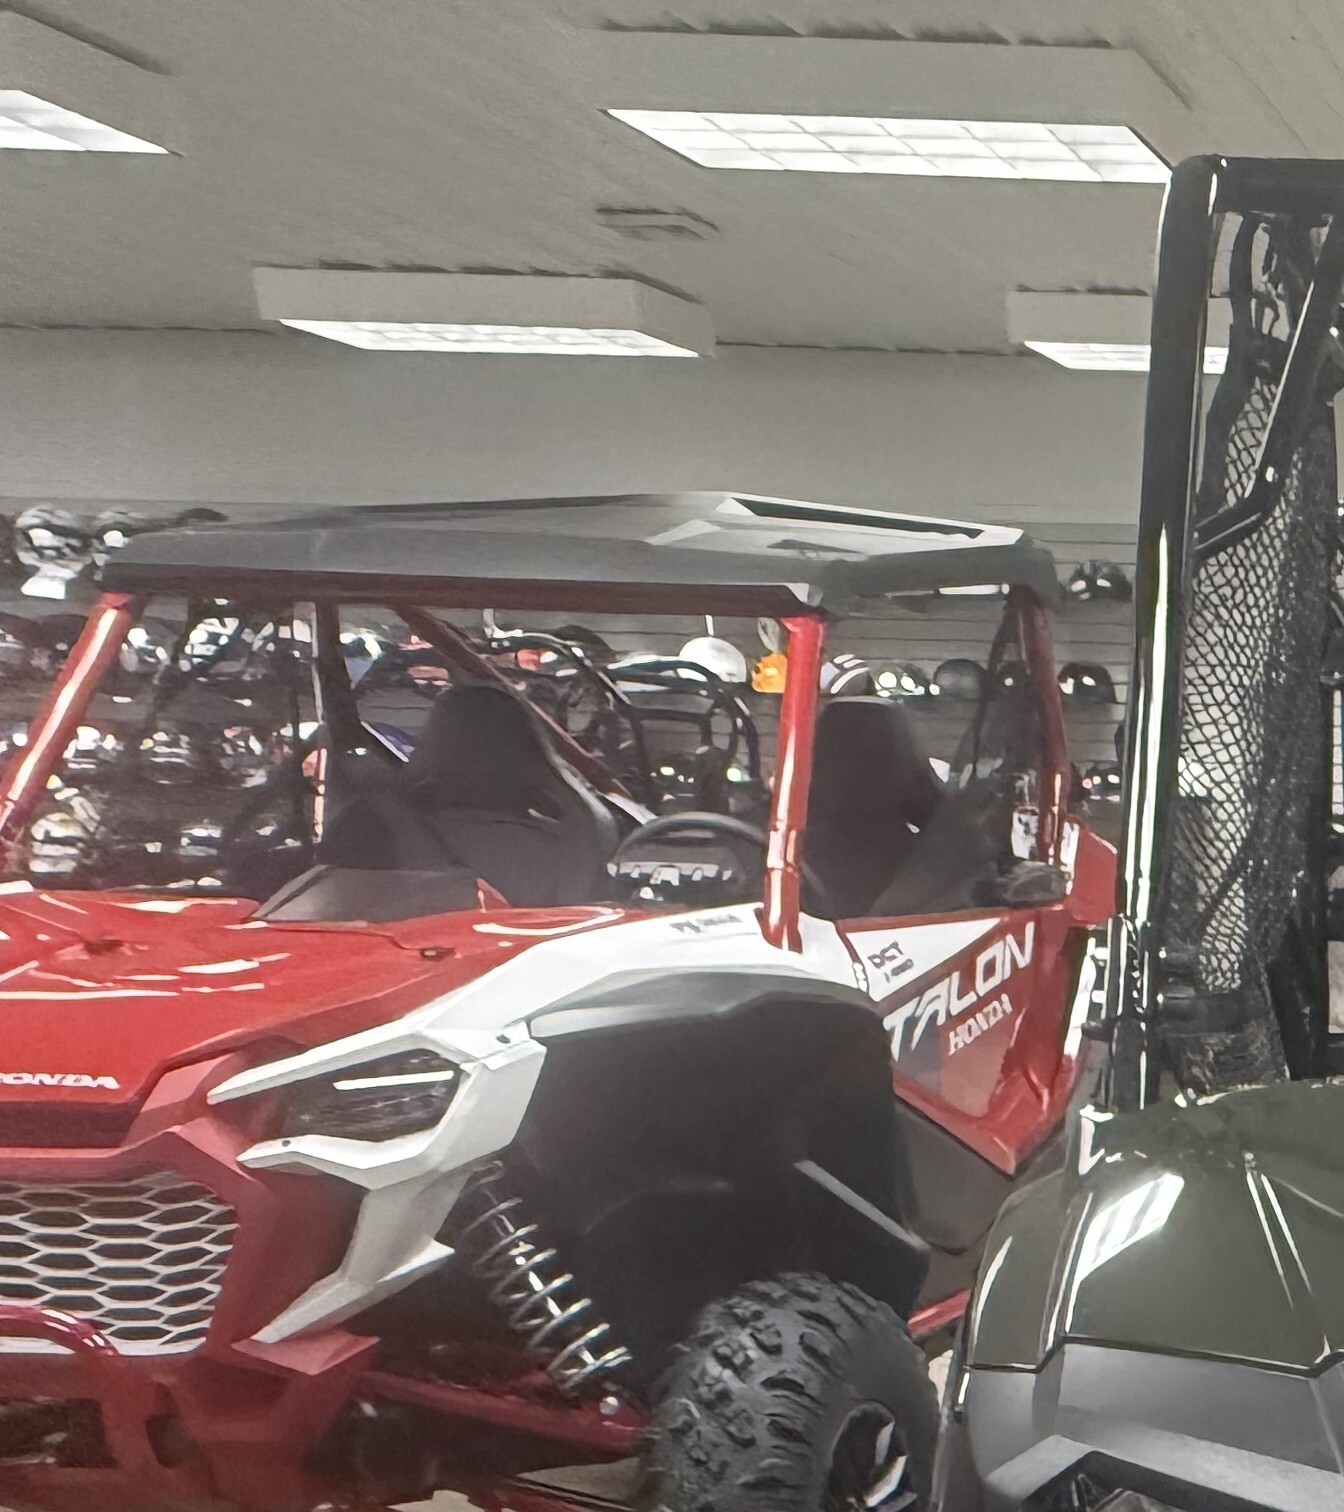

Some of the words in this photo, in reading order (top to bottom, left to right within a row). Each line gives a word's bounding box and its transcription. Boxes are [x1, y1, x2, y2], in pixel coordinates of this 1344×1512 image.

[882, 921, 1036, 1062] TALON
[949, 993, 1013, 1056] HONDA
[0, 1072, 120, 1090] ONDA
